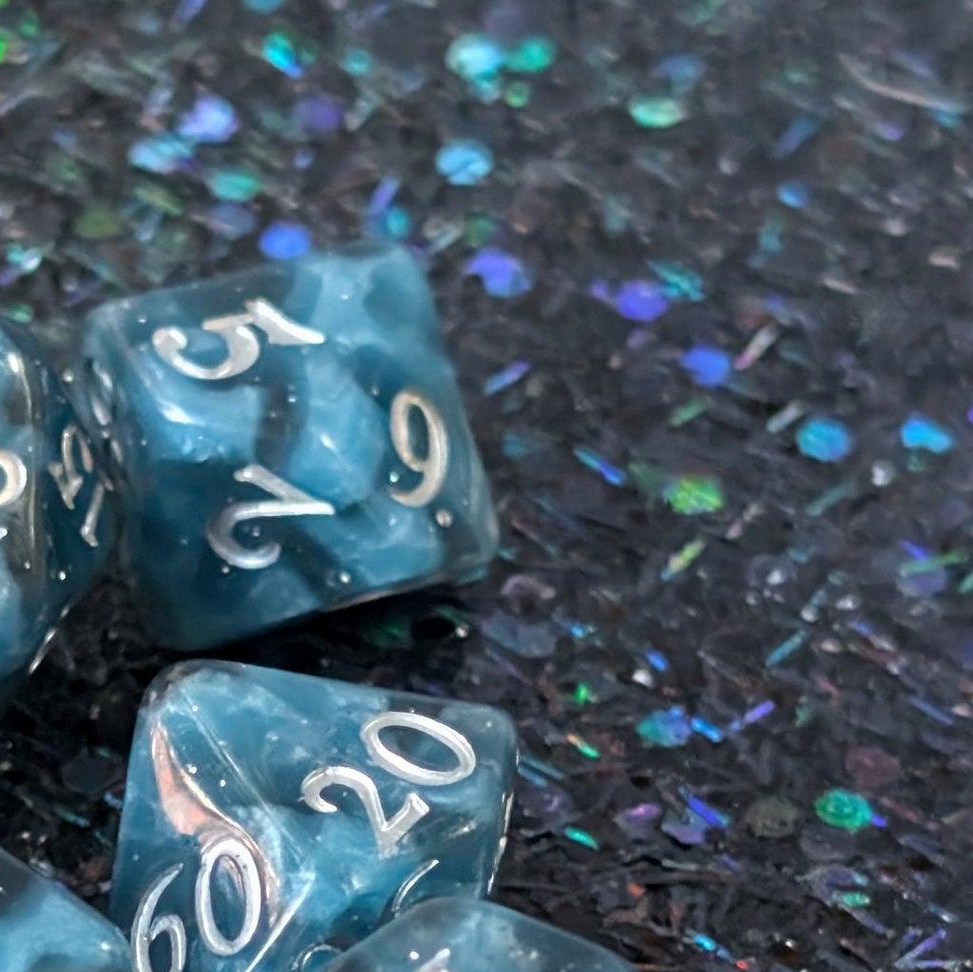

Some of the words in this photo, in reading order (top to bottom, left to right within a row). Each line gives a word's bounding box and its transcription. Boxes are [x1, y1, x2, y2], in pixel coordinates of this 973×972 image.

[152, 298, 325, 380] 5
[207, 464, 336, 569] 2
[301, 711, 476, 859] 20
